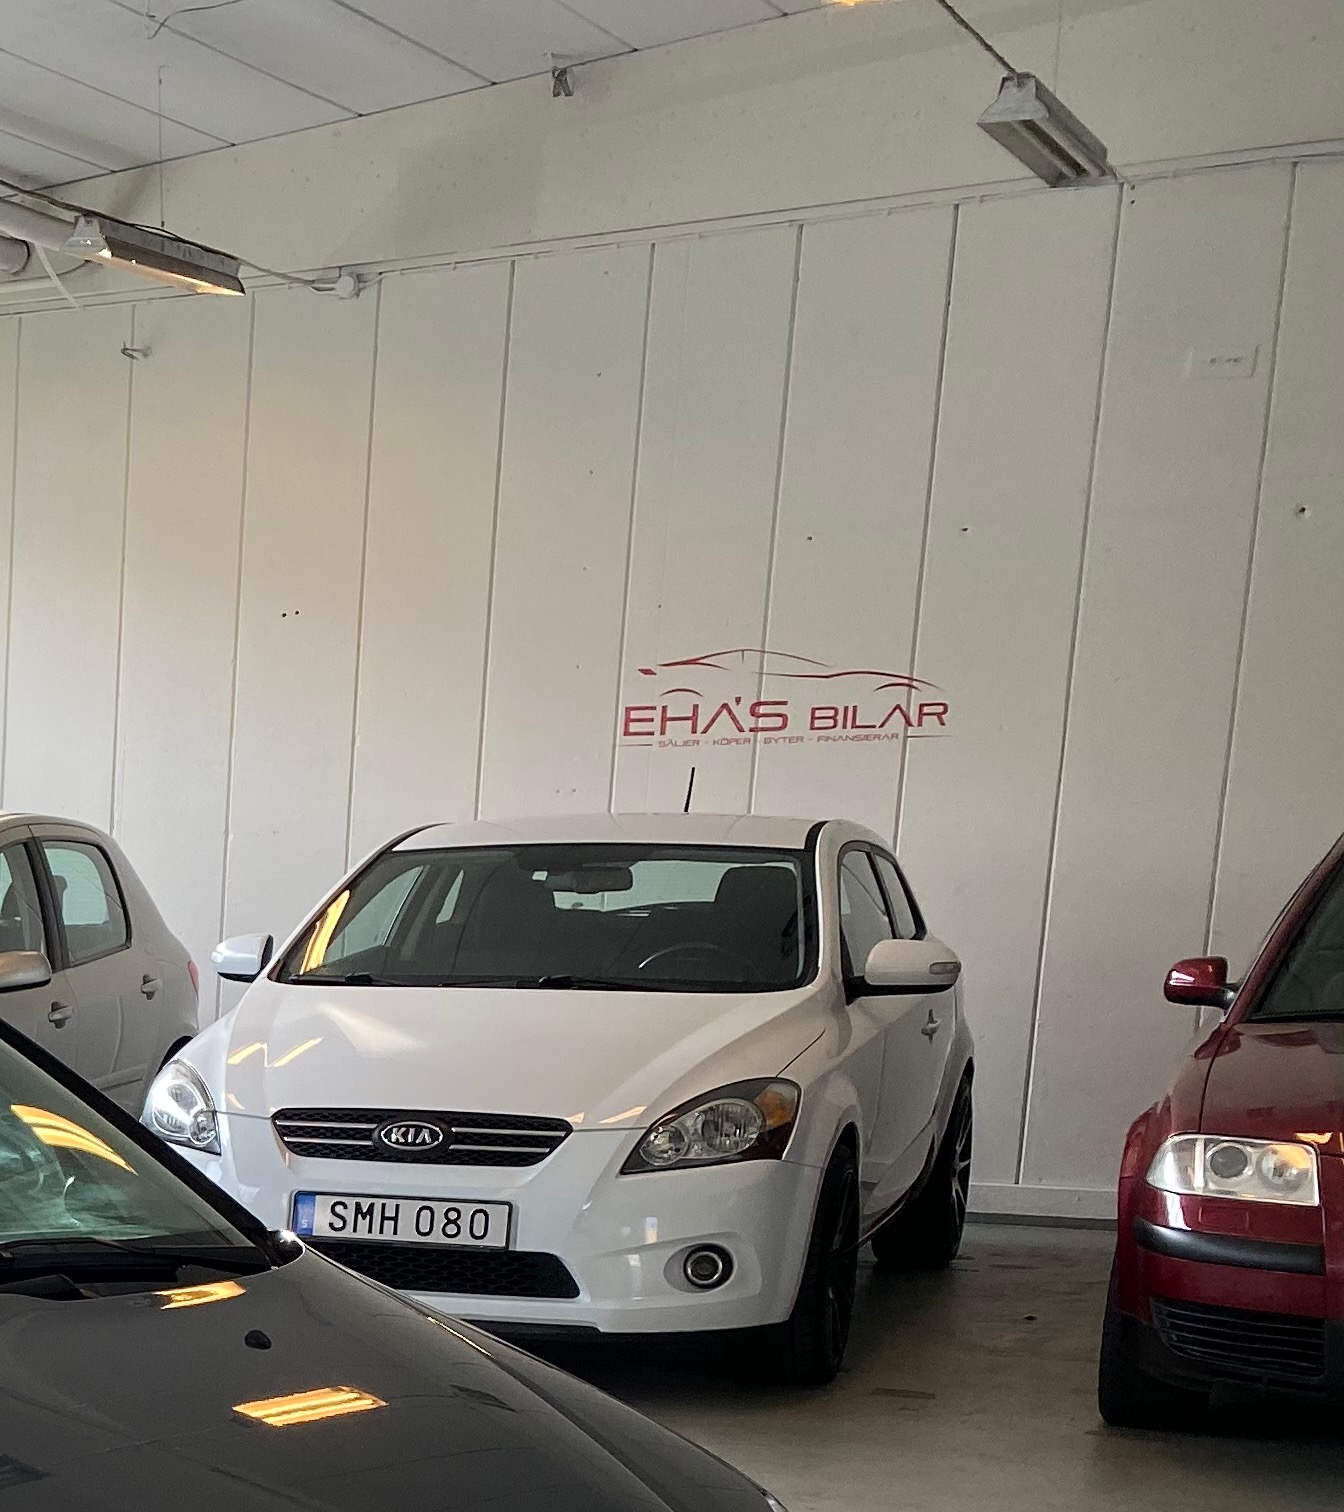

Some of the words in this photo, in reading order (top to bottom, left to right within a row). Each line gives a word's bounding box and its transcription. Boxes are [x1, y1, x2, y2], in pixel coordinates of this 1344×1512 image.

[623, 696, 789, 736] EHA'S
[809, 702, 949, 731] BILAR
[390, 1126, 433, 1144] KIA
[328, 1201, 401, 1236] SMH
[414, 1205, 490, 1240] 080
